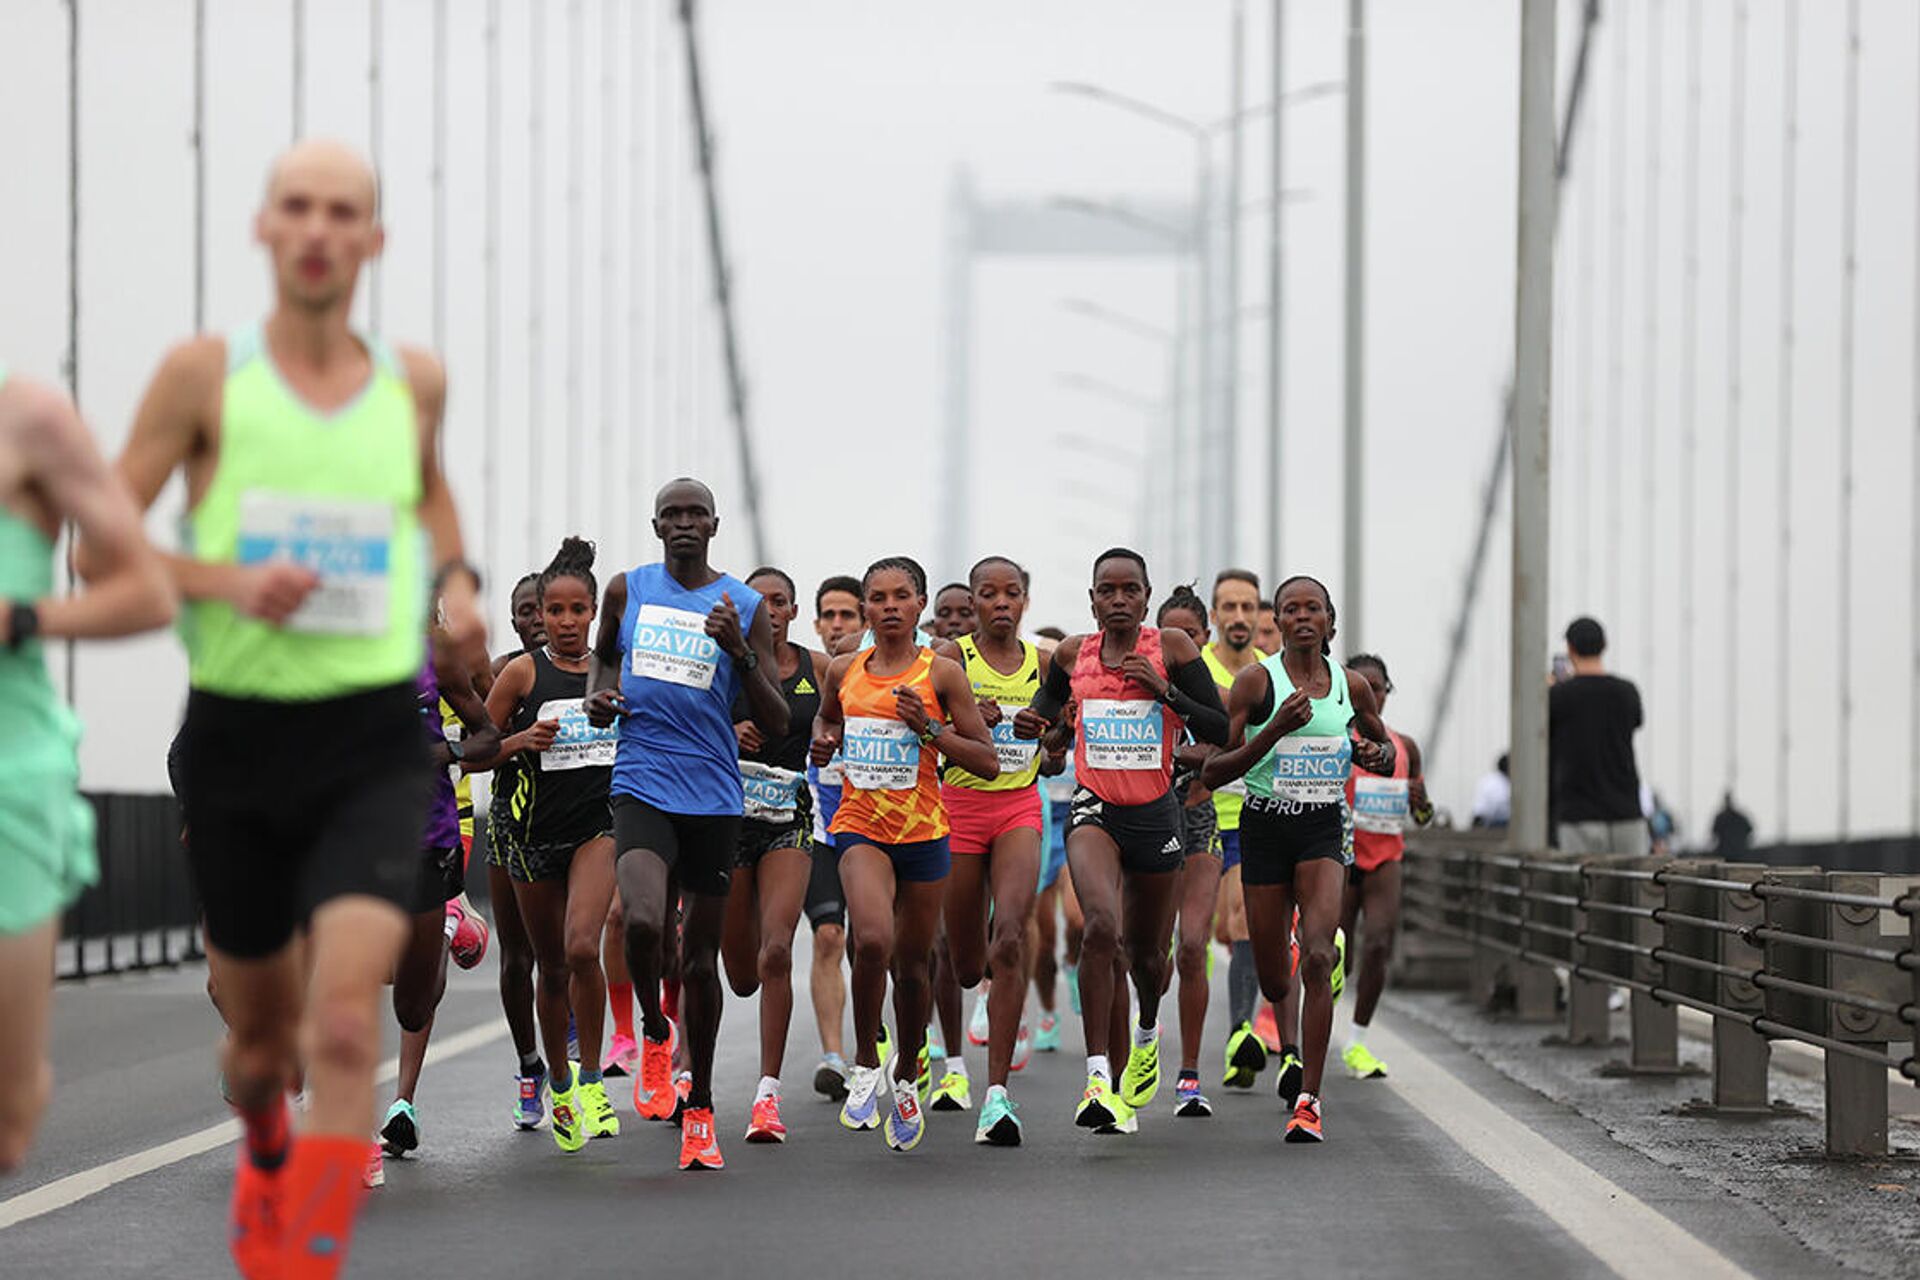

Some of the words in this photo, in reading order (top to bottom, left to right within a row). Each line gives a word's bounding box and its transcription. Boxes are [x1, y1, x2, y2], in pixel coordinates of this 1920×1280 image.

[638, 628, 716, 659] DAVID
[1087, 722, 1157, 740] SALINA
[847, 738, 911, 762] EMILY
[1278, 757, 1347, 777] BENCY
